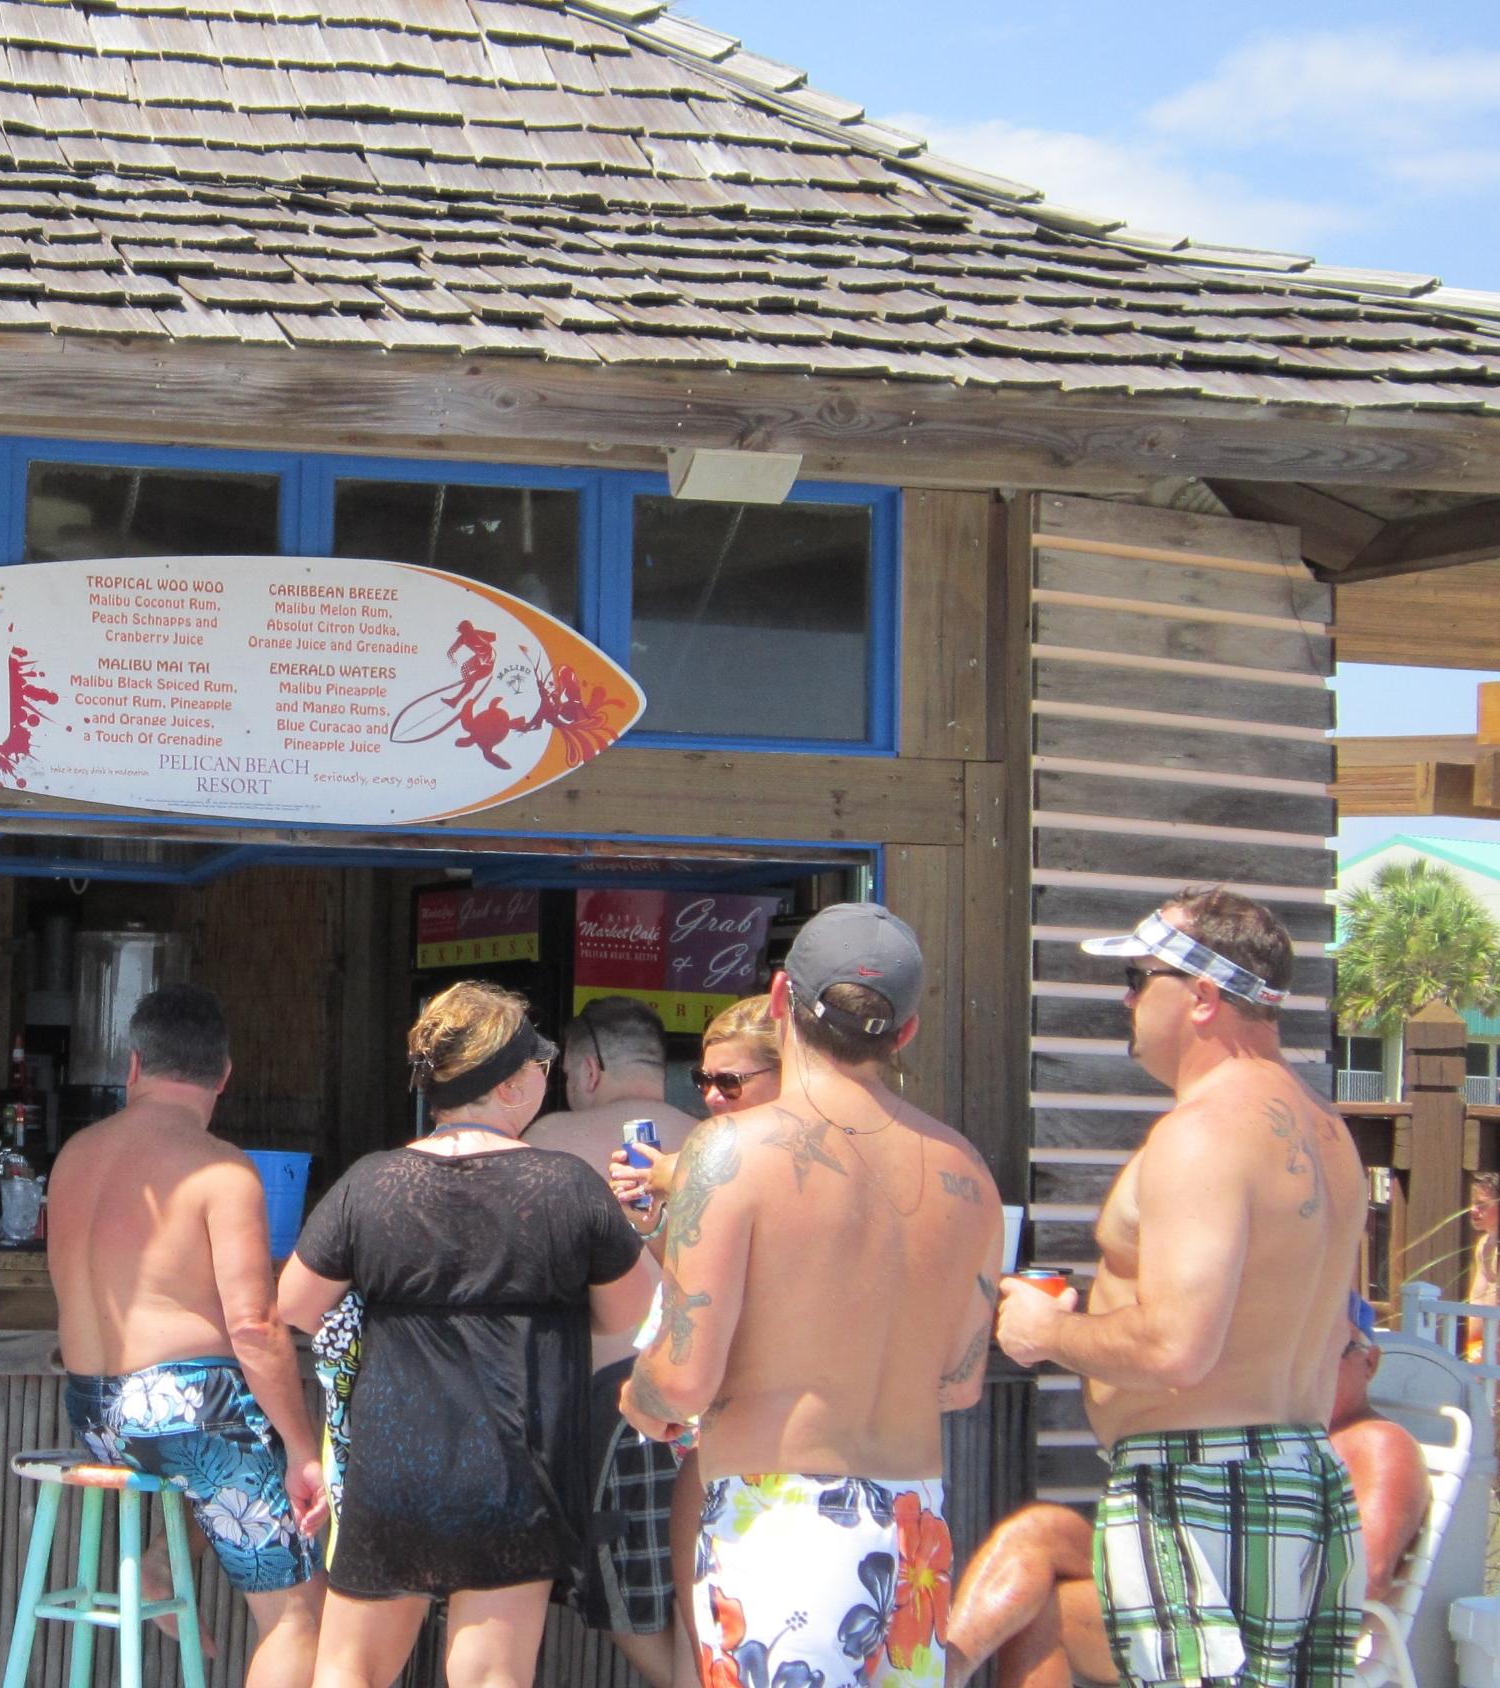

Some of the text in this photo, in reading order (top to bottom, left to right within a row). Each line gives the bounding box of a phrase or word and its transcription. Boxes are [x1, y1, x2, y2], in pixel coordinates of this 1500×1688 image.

[86, 575, 224, 594] TROPICAL WOO WOO
[269, 583, 399, 601] CARIBBEAN BREEZE
[89, 593, 131, 608] Malibu
[135, 596, 185, 609] Coconut
[274, 602, 316, 615] Malibu
[320, 603, 357, 617] Melon
[92, 611, 218, 629] Peach Schnapps and
[267, 619, 313, 632] Absolut
[317, 621, 355, 634] Citron
[105, 629, 204, 646] Cranberry Juice
[248, 635, 419, 655] Orange Juice and Grenadine
[98, 658, 210, 674] MALIBU MAI TAI
[269, 662, 397, 679] EMERALD WATERS
[496, 664, 531, 681] MALIBU
[70, 675, 113, 688] Malibu
[117, 677, 153, 690] Black
[157, 678, 200, 692] Spiced
[279, 681, 388, 698] Malibu Pineapple
[75, 693, 129, 707] Coconut
[170, 697, 233, 711] Pineapple
[275, 701, 298, 713] and
[302, 701, 346, 715] Mango
[92, 713, 116, 725] and
[119, 713, 167, 726] Orange
[277, 718, 389, 735] Blue Curacao and
[83, 731, 223, 747] a Touch Of Grenadine
[284, 738, 381, 753] Pineapple Juice
[158, 753, 311, 775] PELICAN BEACH
[196, 776, 272, 795] RESORT
[372, 776, 403, 788] easy
[406, 775, 437, 790] going
[669, 898, 763, 943] Grab
[579, 921, 630, 940] Market
[420, 938, 534, 964] EXPRESS
[702, 943, 754, 989] Go
